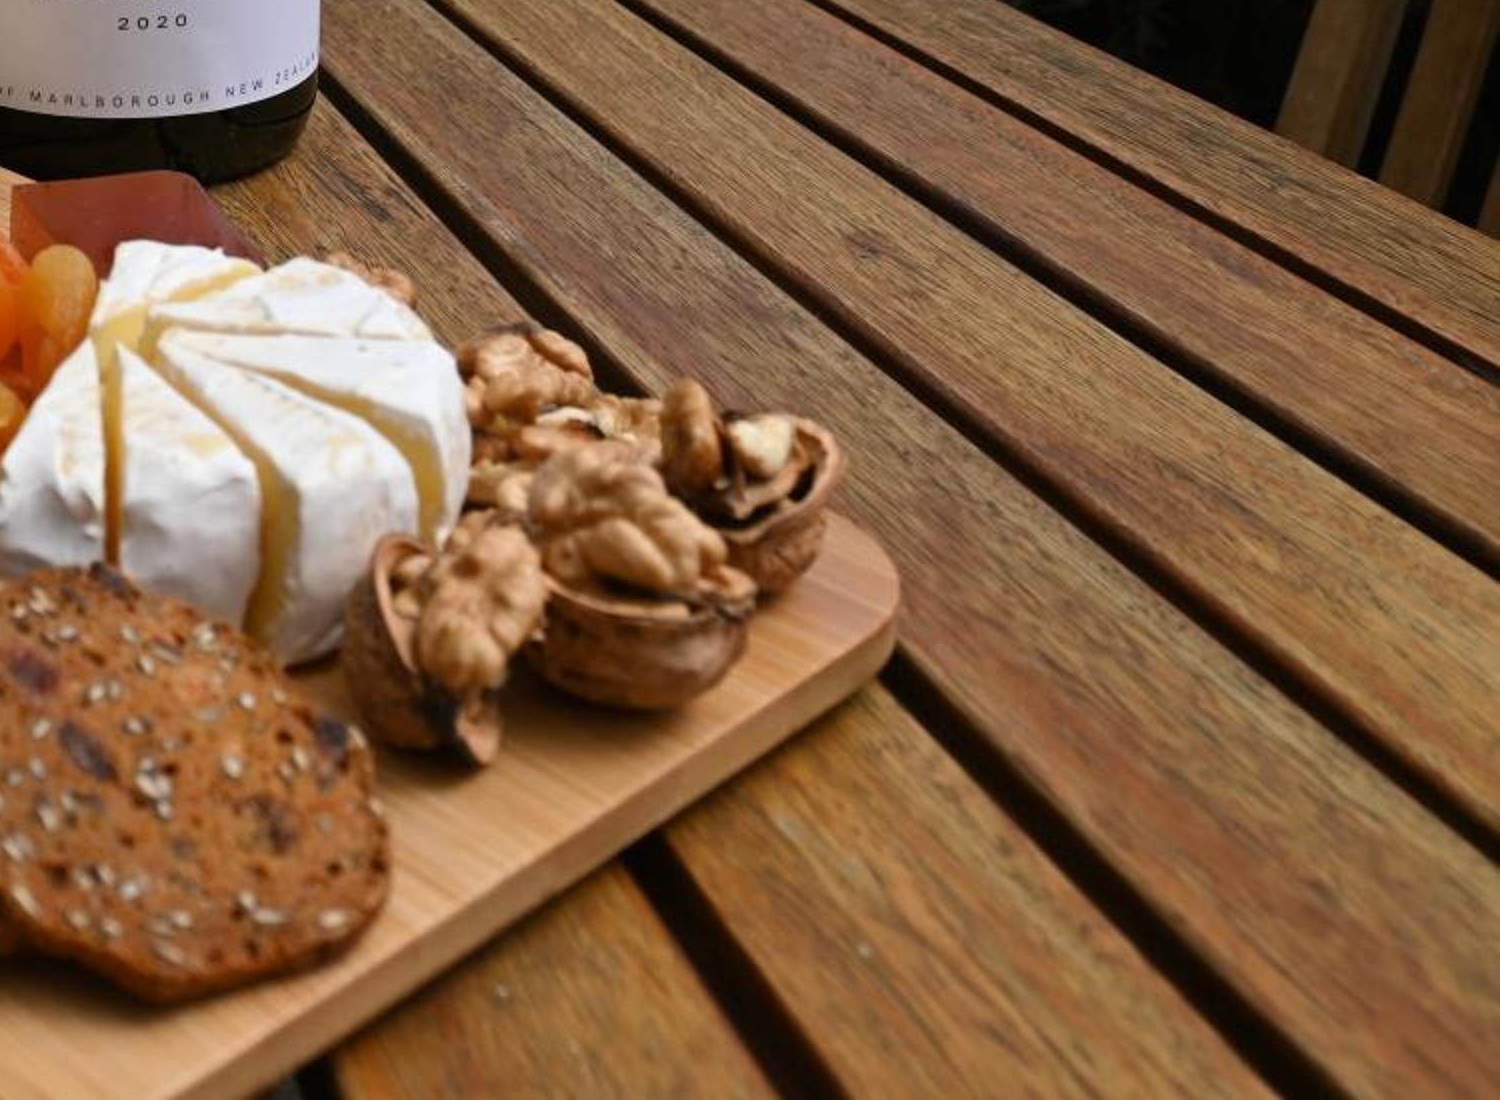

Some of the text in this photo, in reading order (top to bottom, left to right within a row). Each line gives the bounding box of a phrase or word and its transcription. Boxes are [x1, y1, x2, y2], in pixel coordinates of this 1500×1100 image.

[117, 13, 188, 31] 2020
[29, 90, 210, 109] MARLBOROUGH
[225, 79, 264, 99] NEW
